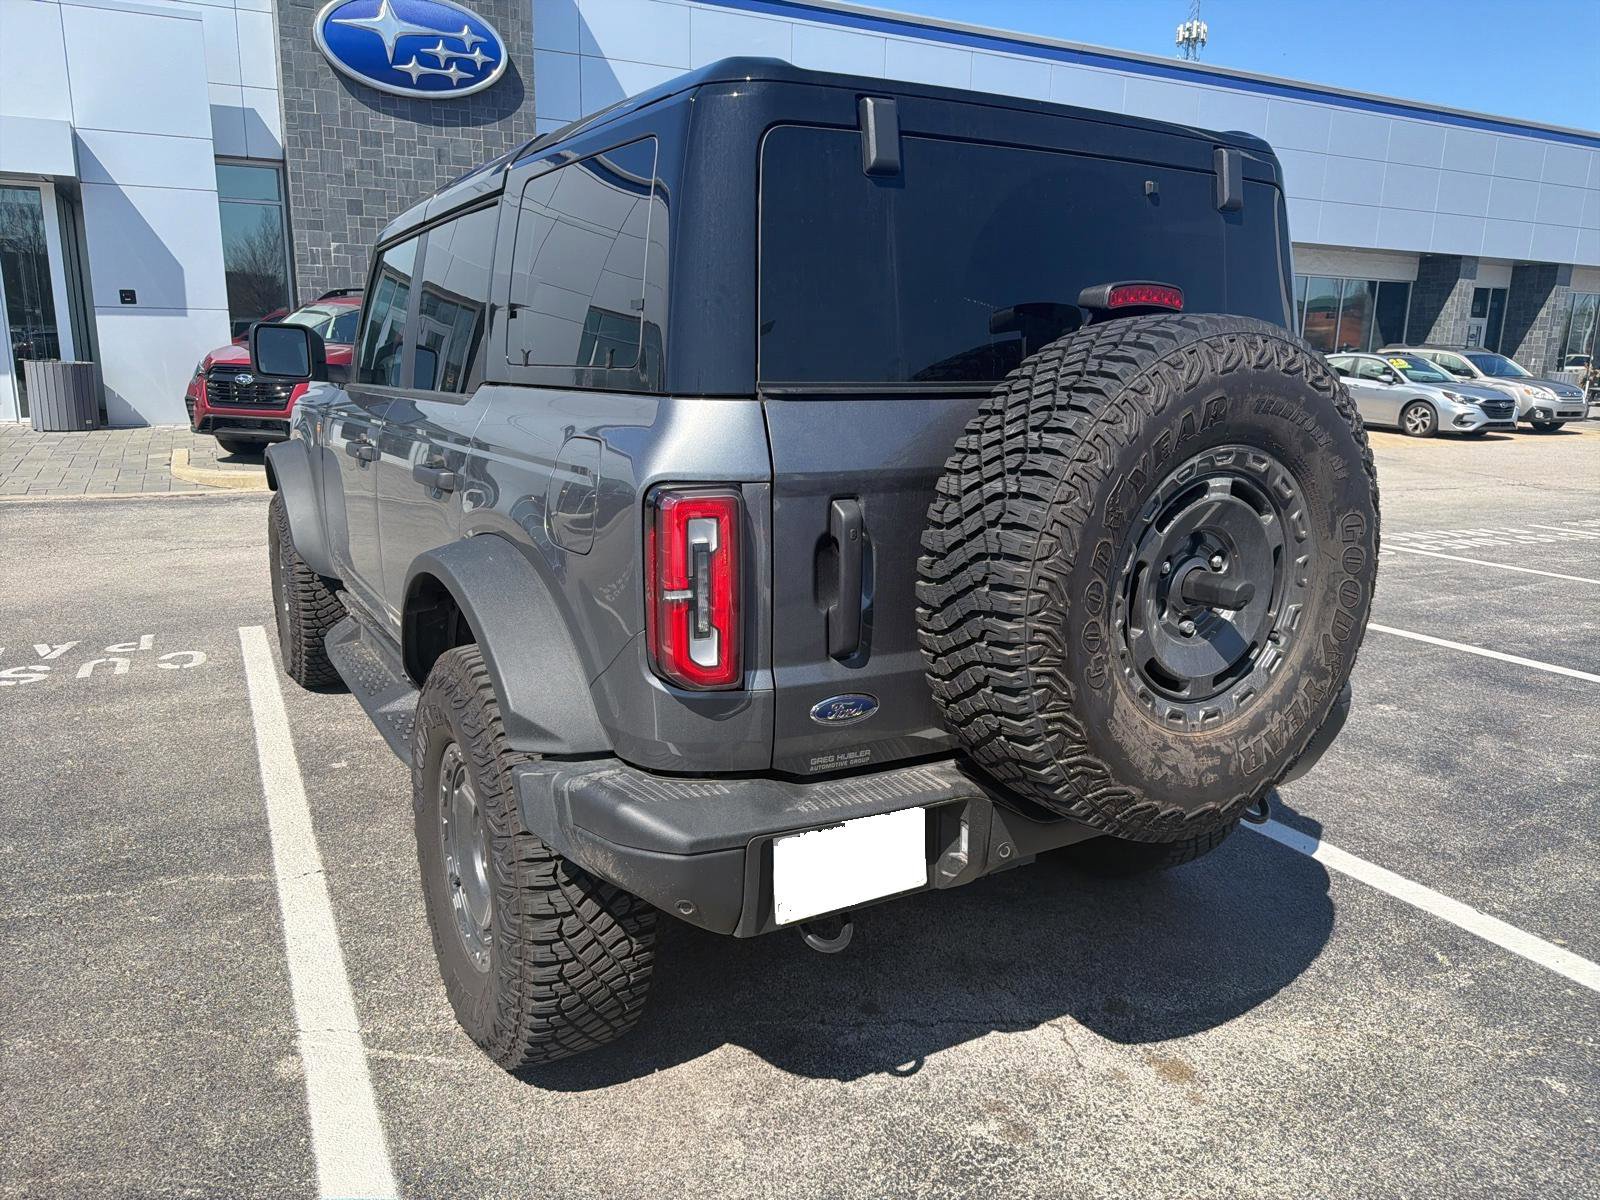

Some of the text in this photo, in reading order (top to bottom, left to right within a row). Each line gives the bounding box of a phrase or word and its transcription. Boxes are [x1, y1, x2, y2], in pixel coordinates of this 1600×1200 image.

[827, 701, 864, 720] Ford
[809, 757, 870, 771] AUTOMOTIVE GROUP
[810, 749, 871, 766] GREG HUBLER
